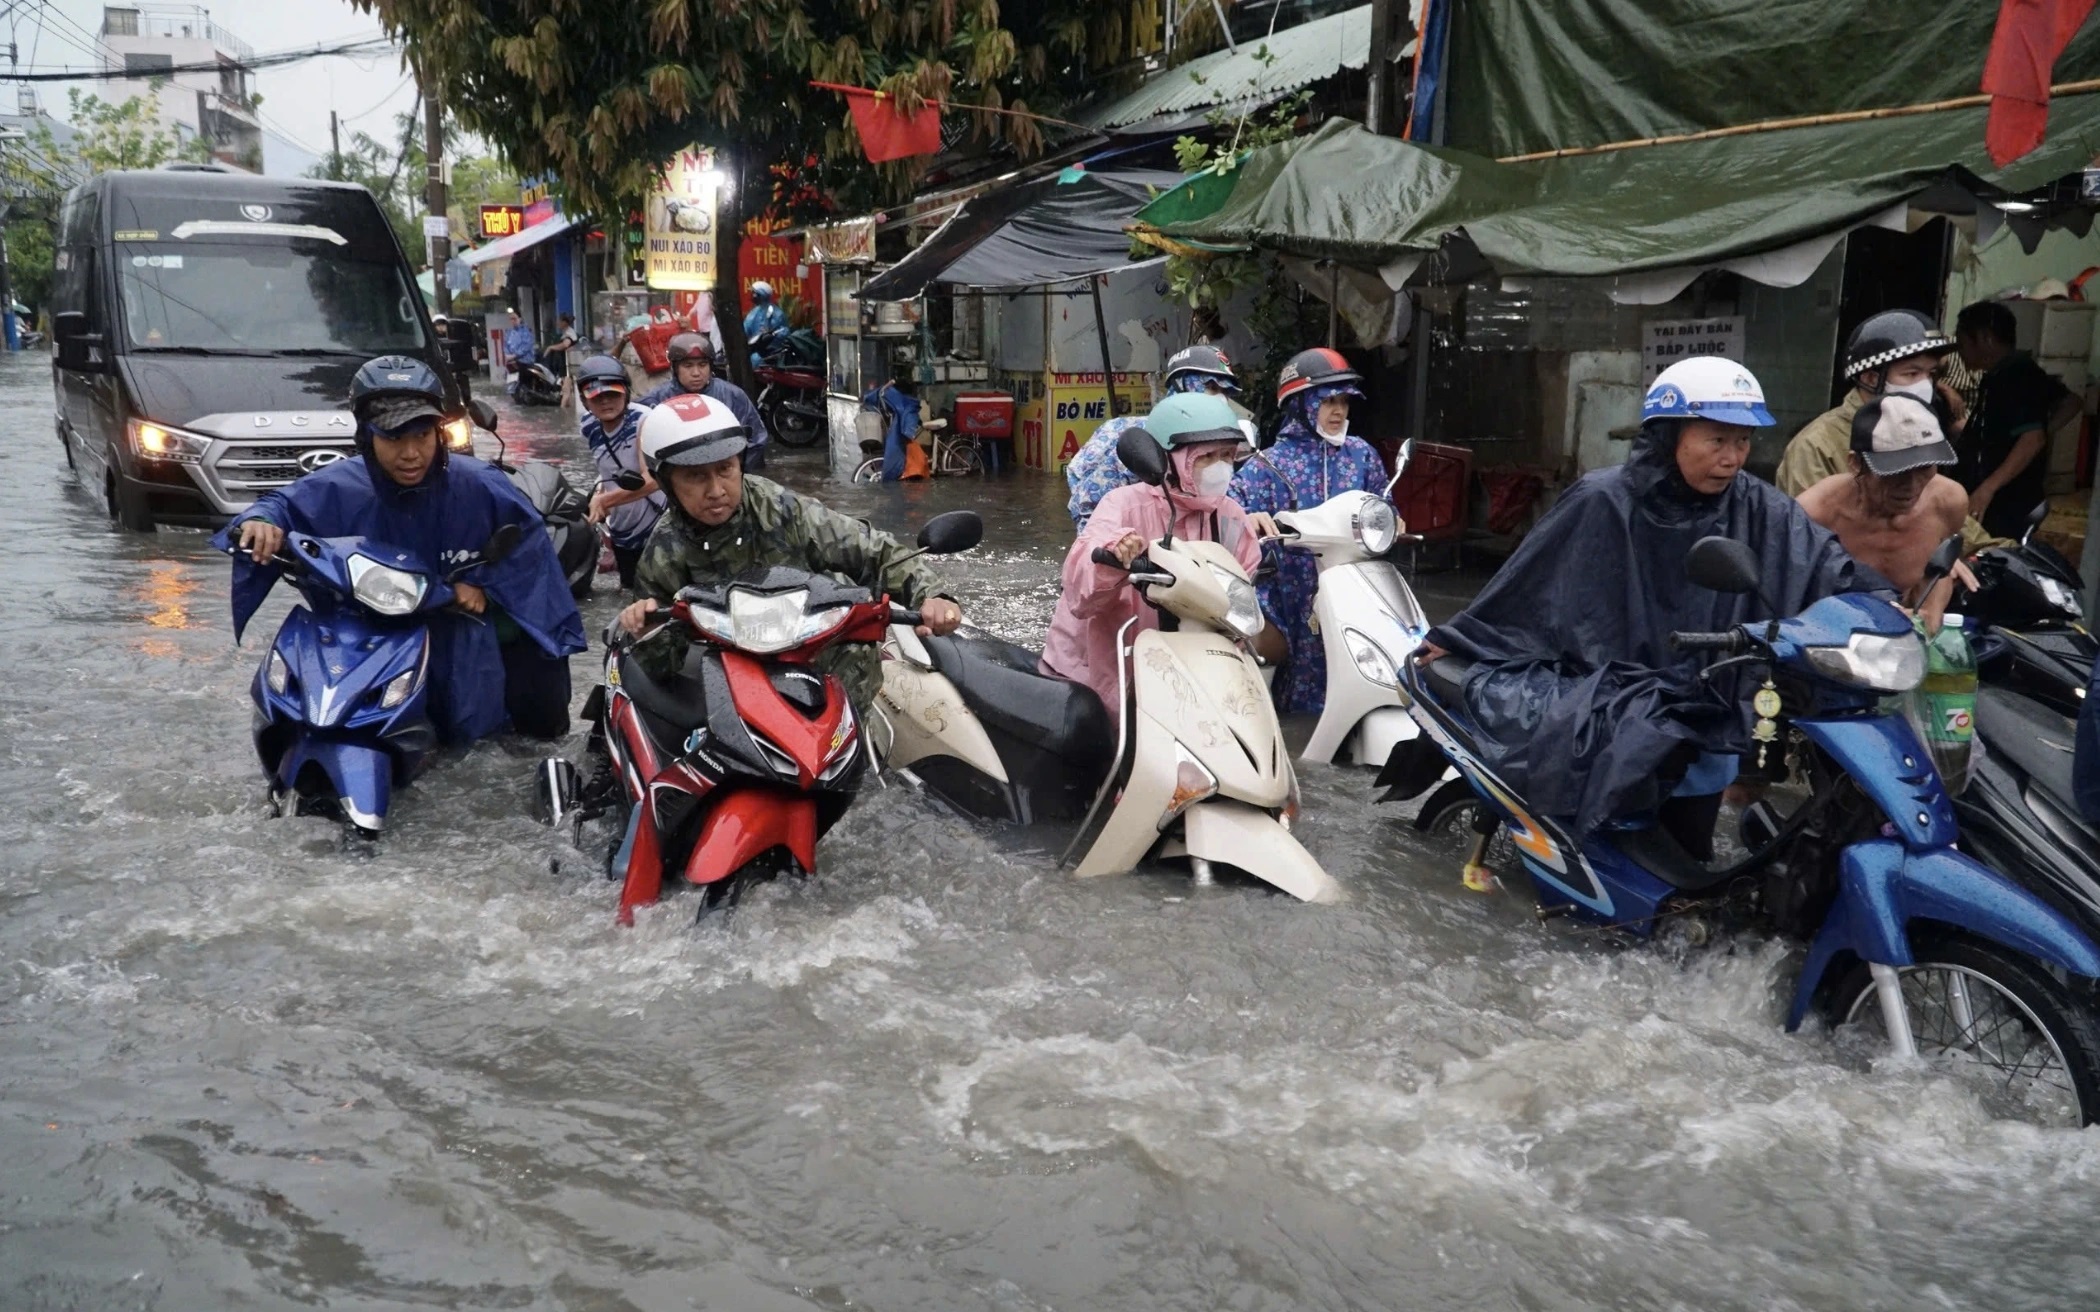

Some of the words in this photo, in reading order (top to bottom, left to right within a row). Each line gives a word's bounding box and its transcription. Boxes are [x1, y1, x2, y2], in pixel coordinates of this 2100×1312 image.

[483, 207, 509, 233] THÚ
[510, 212, 521, 233] Y
[651, 239, 669, 253] NUI
[744, 277, 802, 295] NANH
[1084, 397, 1107, 419] NÉ
[785, 673, 821, 686] HONDA
[698, 749, 725, 775] HONDA
